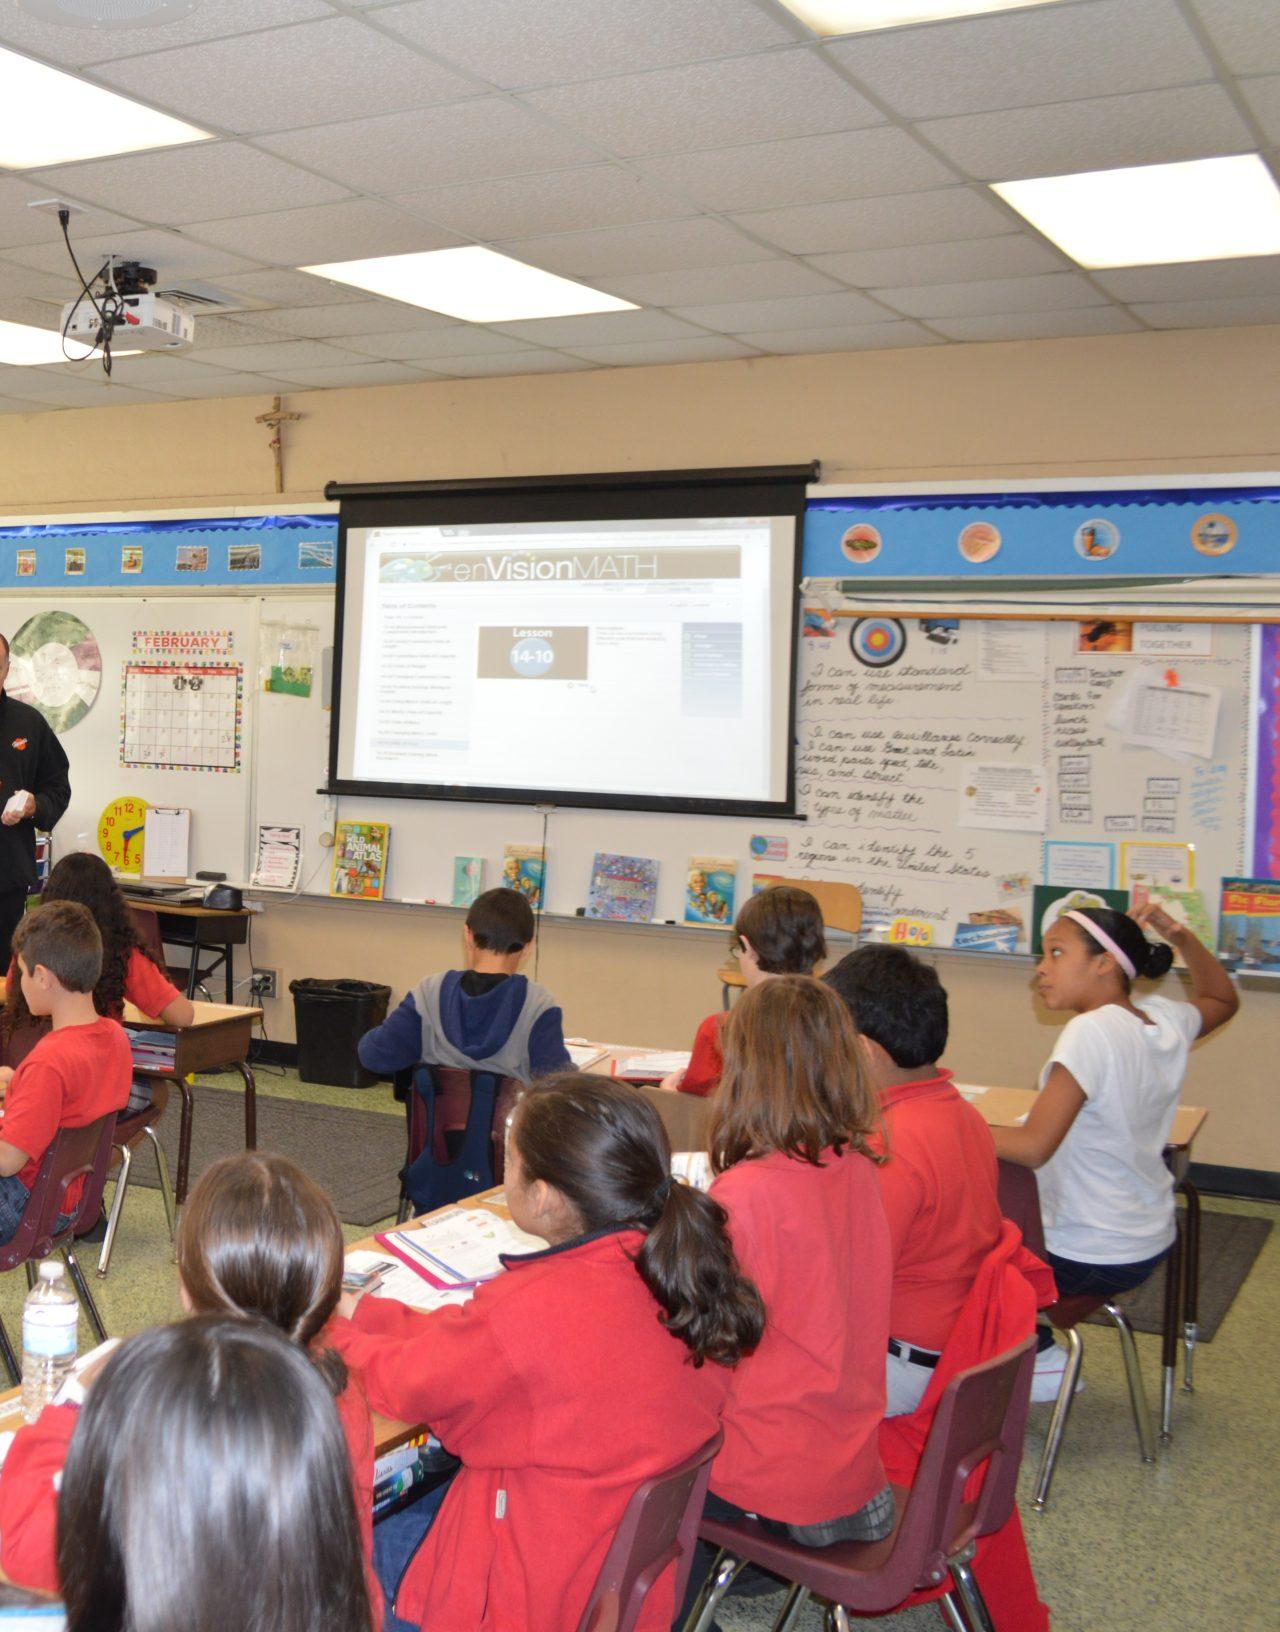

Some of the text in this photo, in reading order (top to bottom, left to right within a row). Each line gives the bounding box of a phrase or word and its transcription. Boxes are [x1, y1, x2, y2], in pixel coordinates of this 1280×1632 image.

[453, 553, 658, 582] enVisionMATH
[512, 627, 553, 639] Lesson
[144, 637, 220, 648] FEBRUARY
[1139, 640, 1193, 649] TOGETHER
[510, 648, 554, 664] 14-10
[827, 666, 857, 677] can
[897, 664, 972, 677] standard
[828, 730, 856, 740] can
[819, 743, 846, 753] can
[815, 788, 842, 800] can
[903, 791, 925, 806] the
[114, 806, 123, 817] 11
[125, 803, 134, 814] 12
[105, 816, 116, 827] 10
[346, 843, 382, 854] ANIMAL
[822, 838, 850, 850] can
[857, 838, 917, 858] identify
[923, 843, 952, 859] the
[352, 850, 383, 861] ATLAS
[858, 881, 903, 907] dentify
